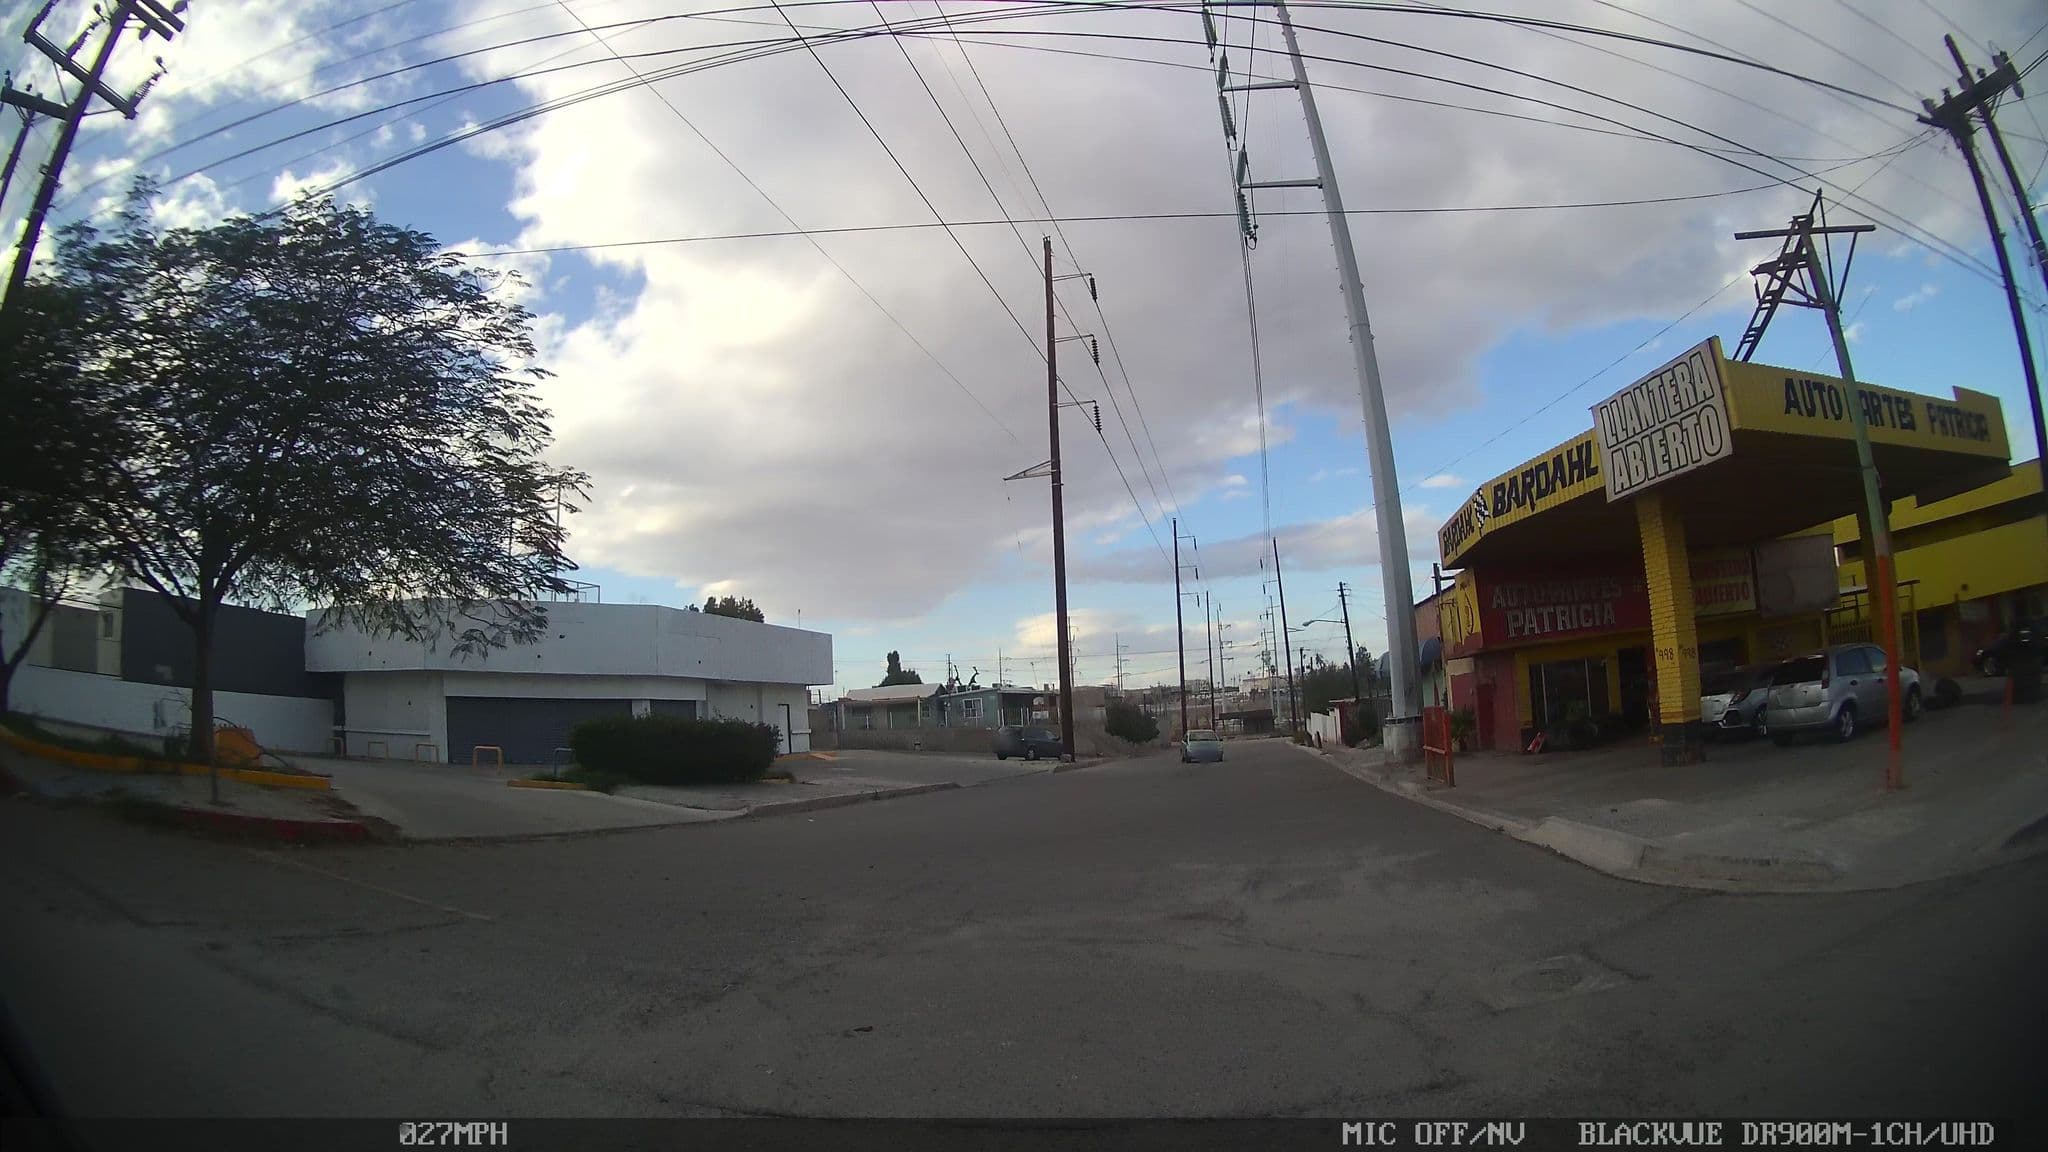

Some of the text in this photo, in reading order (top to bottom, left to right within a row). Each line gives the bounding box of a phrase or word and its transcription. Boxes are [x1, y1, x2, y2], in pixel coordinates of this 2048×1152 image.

[1600, 350, 1715, 449] LLANTERA
[1492, 440, 1599, 518] BARDAHL
[1611, 403, 1723, 495] ABIERTO
[1506, 601, 1617, 639] PATRICIA
